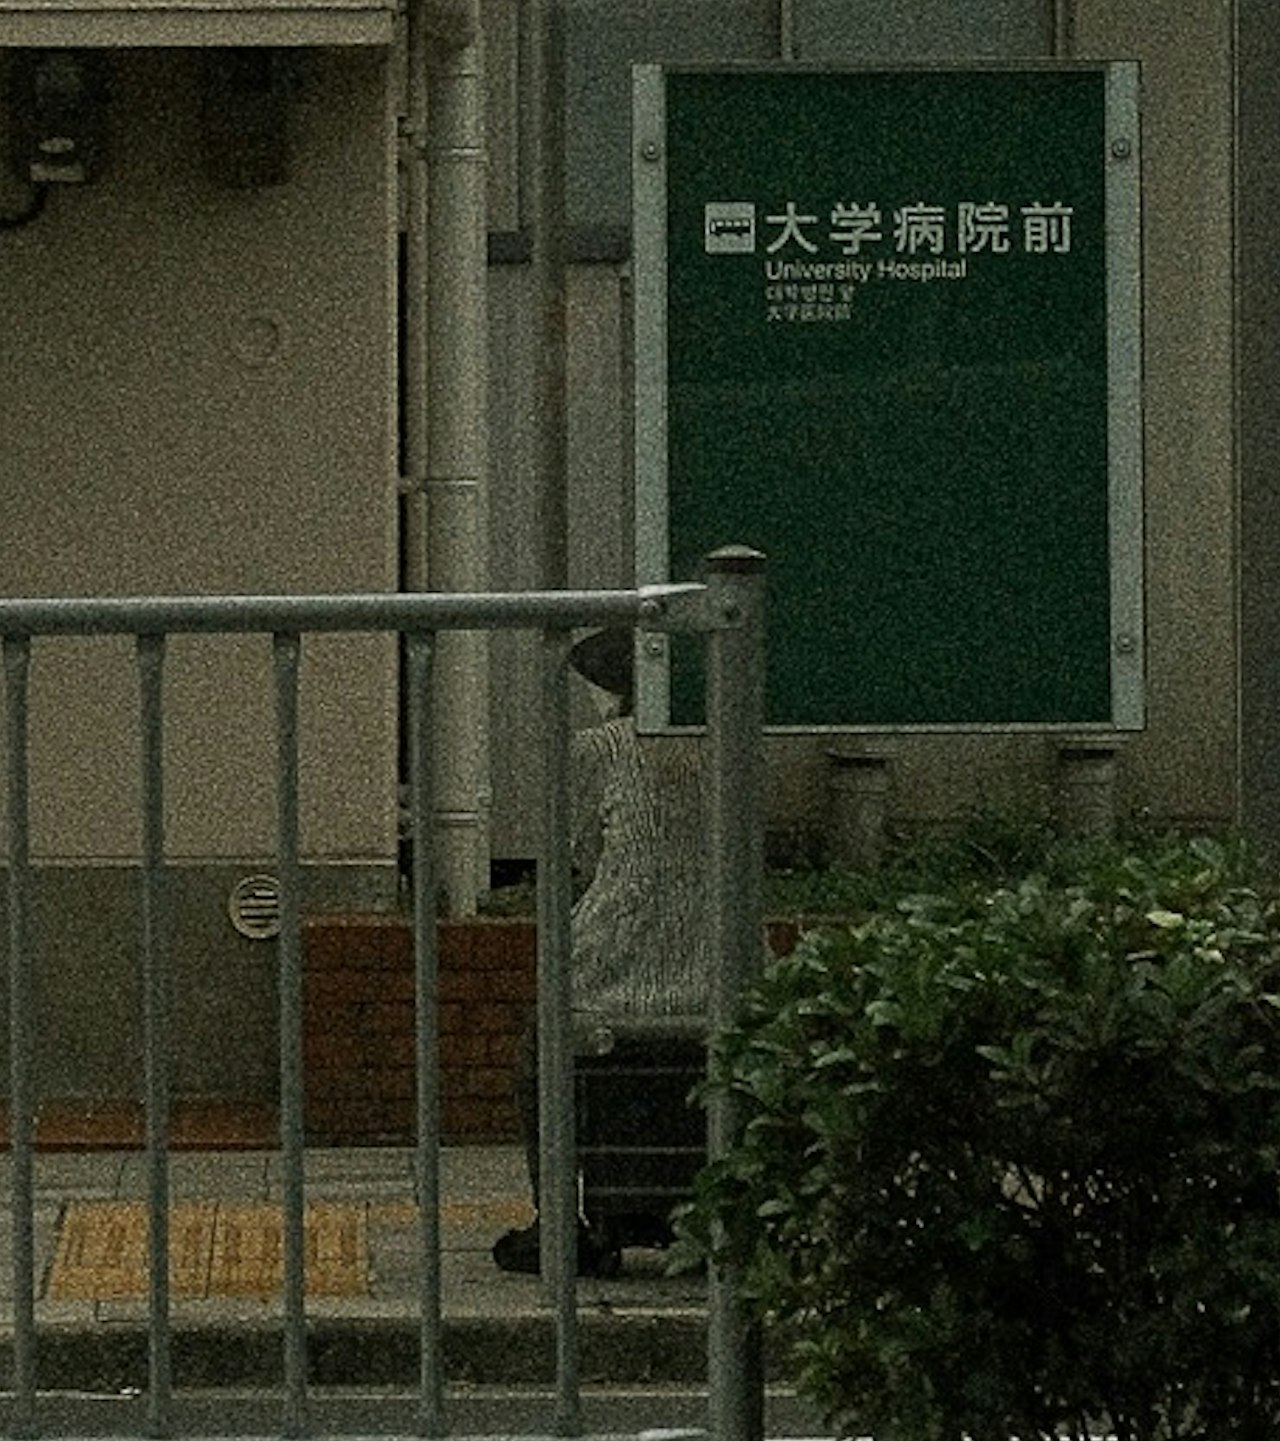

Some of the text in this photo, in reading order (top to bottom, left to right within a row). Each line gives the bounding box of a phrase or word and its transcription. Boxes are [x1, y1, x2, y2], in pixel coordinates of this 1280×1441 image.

[765, 200, 1075, 256] 大学病院前
[765, 259, 968, 283] University Hospital
